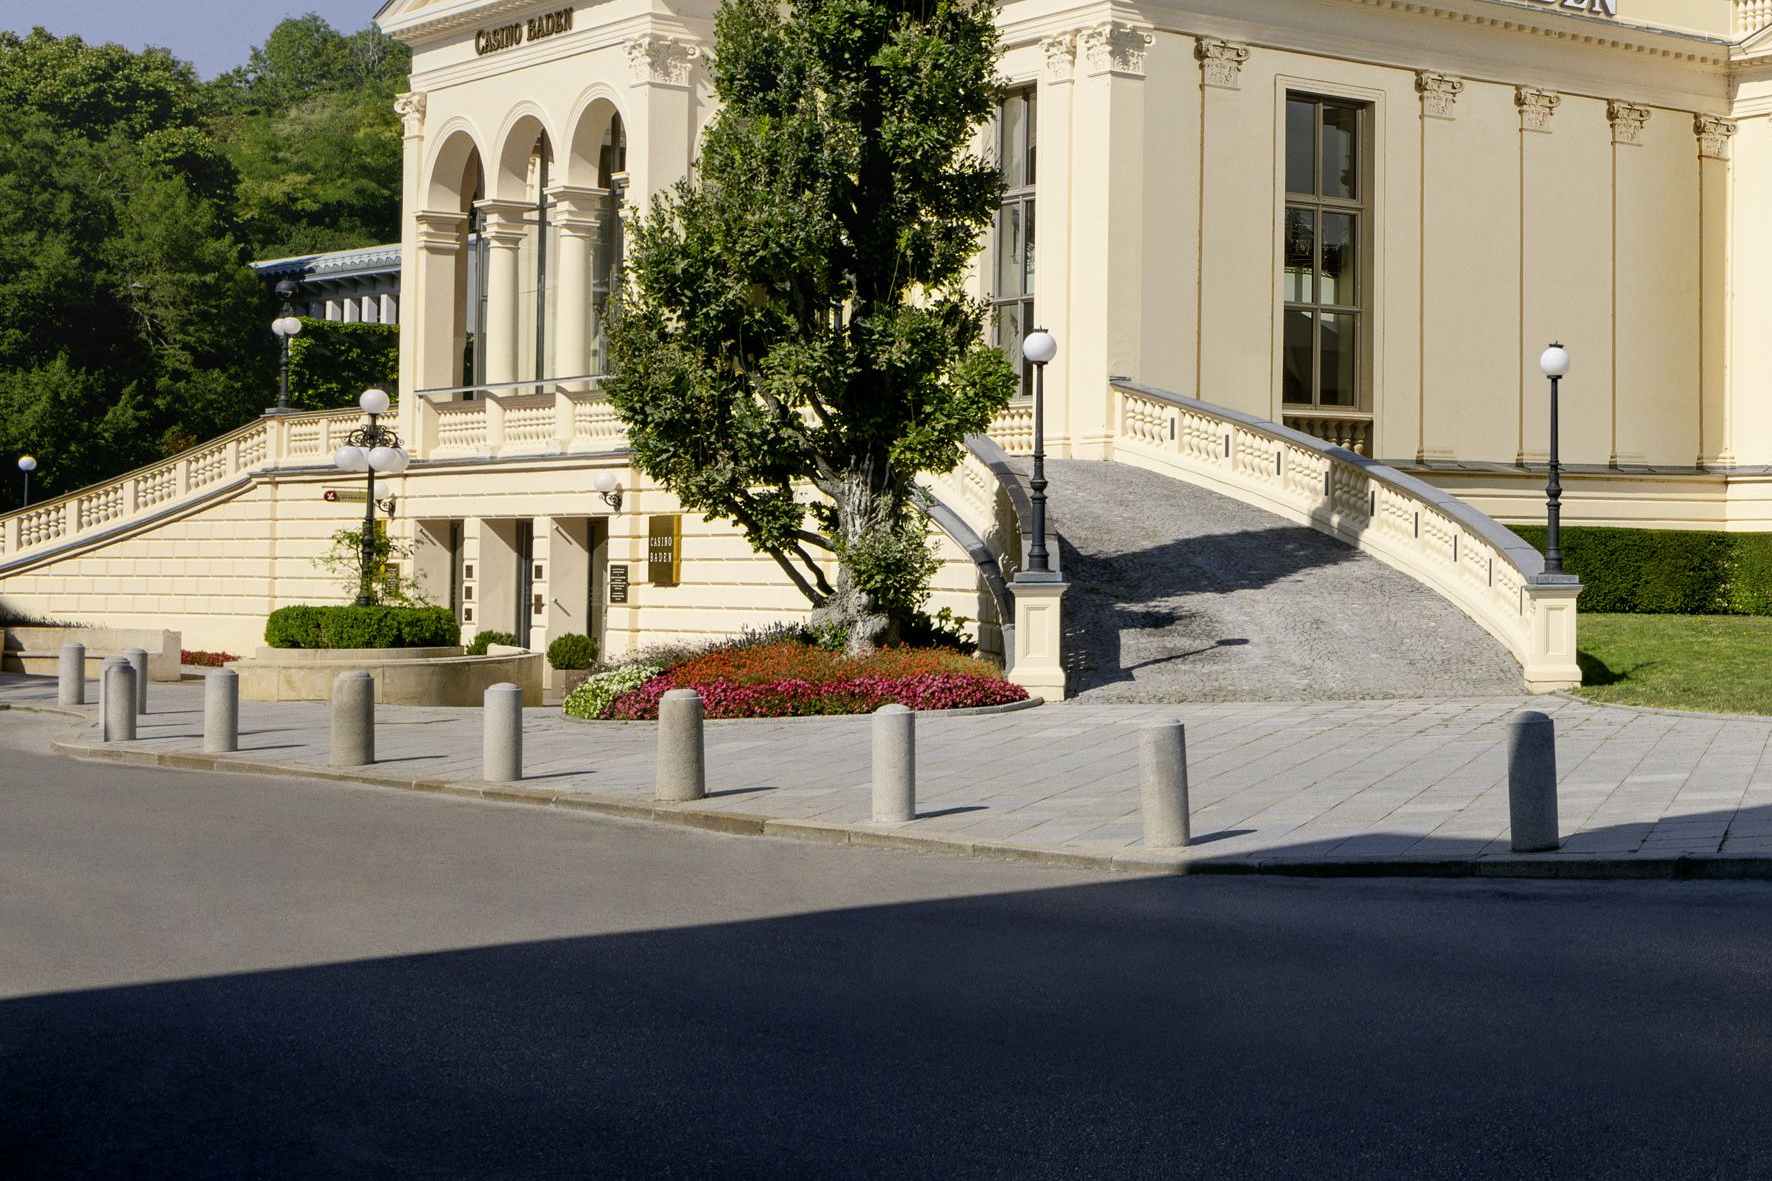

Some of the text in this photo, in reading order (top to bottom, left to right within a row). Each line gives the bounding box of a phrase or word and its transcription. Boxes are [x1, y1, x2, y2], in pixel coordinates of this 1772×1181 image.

[474, 6, 574, 56] CASINO BADEN
[649, 536, 673, 547] CASINO
[649, 552, 672, 563] BADEN
